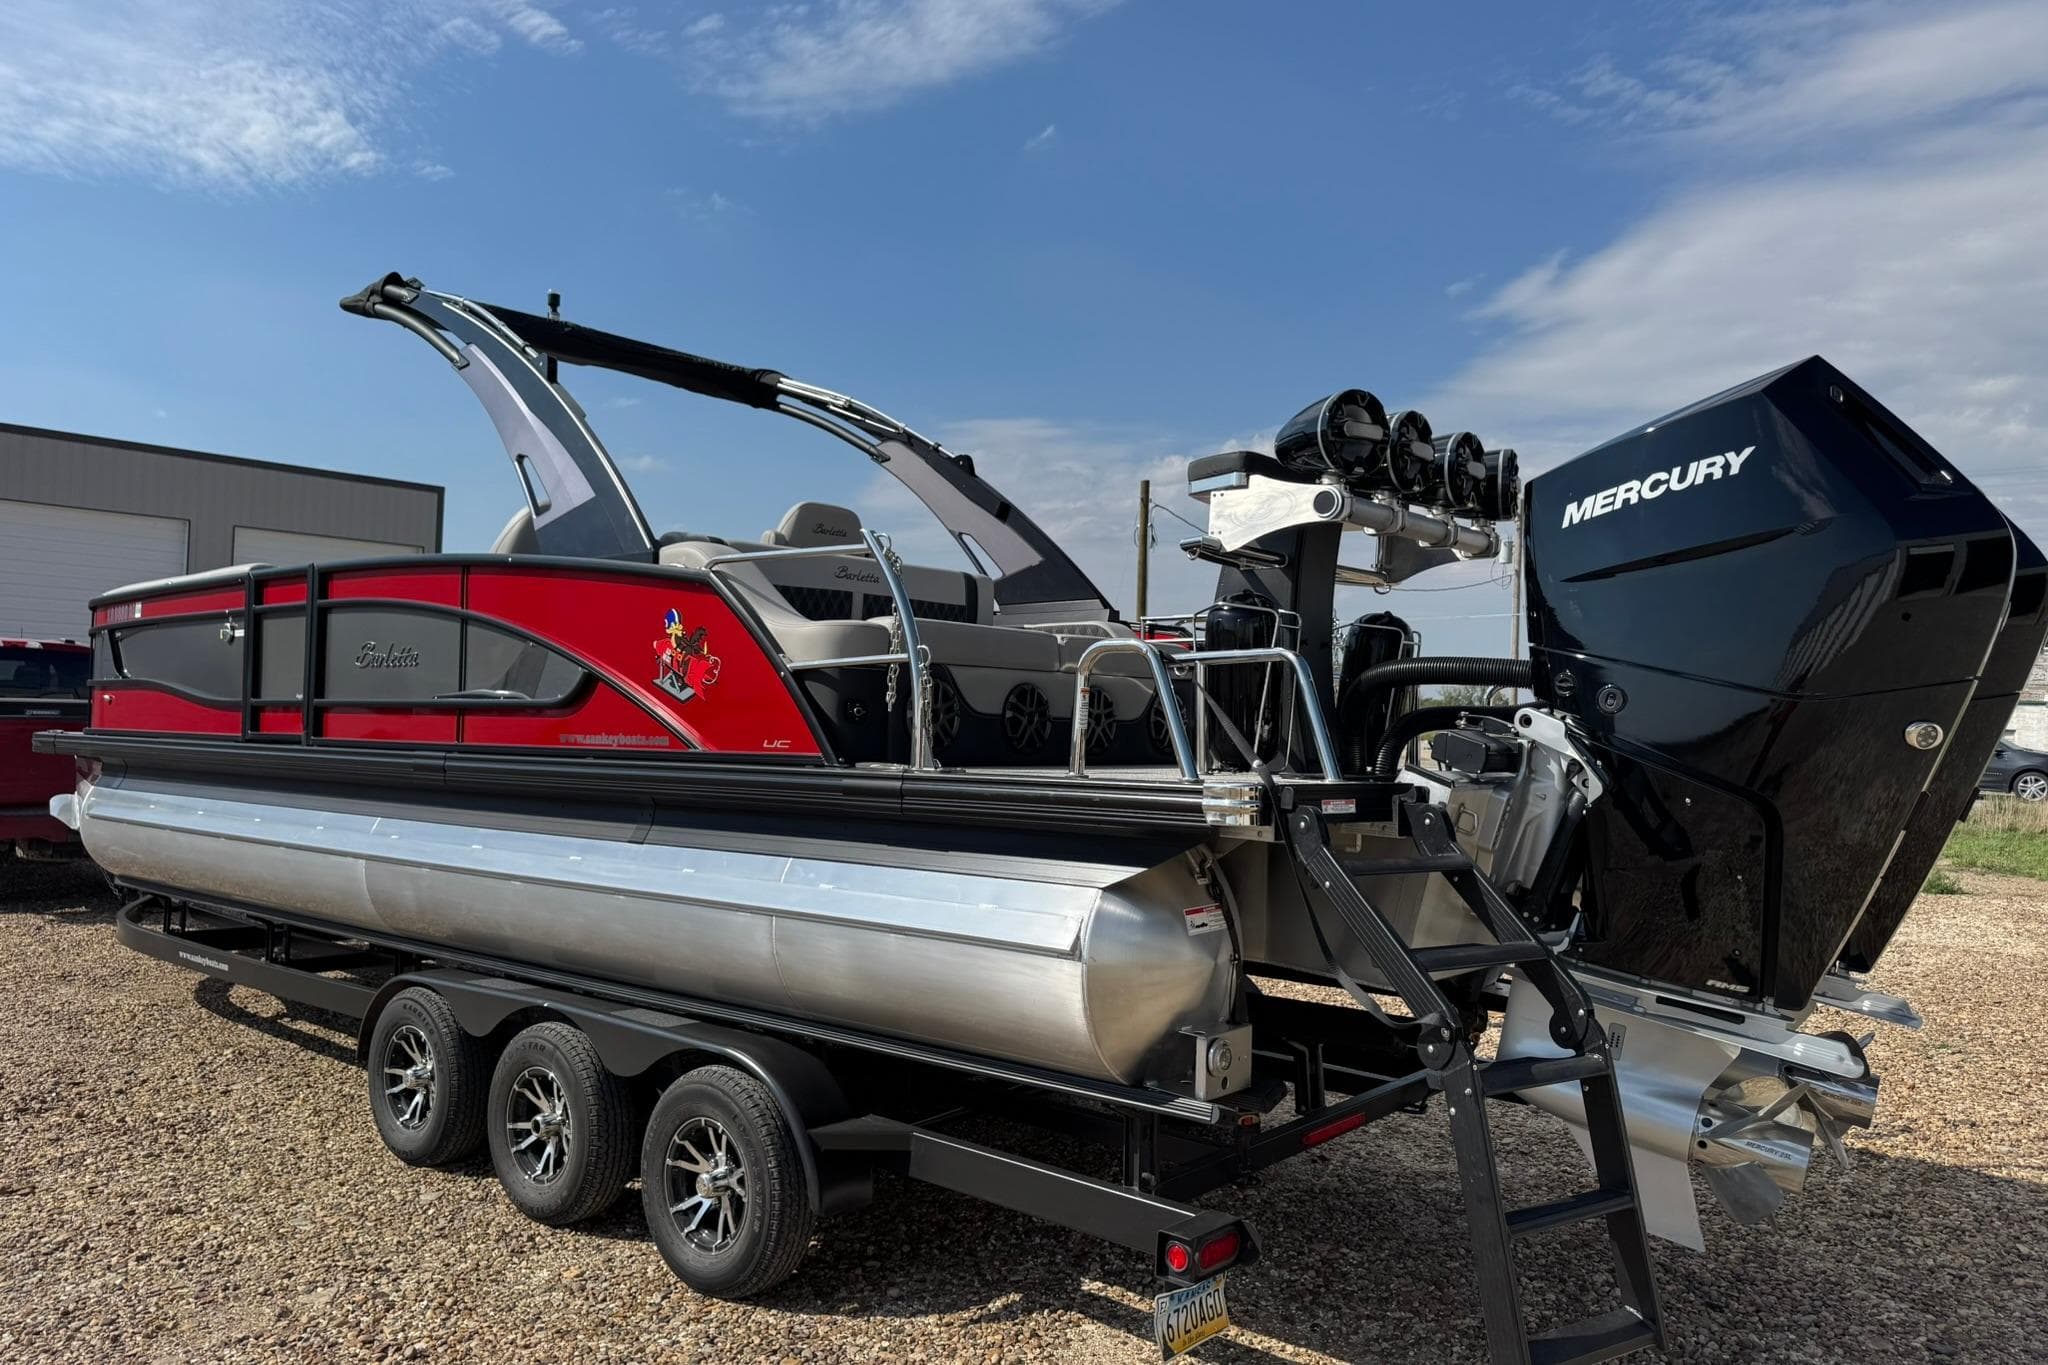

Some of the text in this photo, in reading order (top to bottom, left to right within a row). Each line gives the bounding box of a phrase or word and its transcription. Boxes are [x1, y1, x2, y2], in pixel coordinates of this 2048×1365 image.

[1561, 446, 1756, 529] MERCURY
[813, 523, 848, 537] Barletta
[834, 565, 880, 584] Barletta
[355, 641, 419, 669] Barletta
